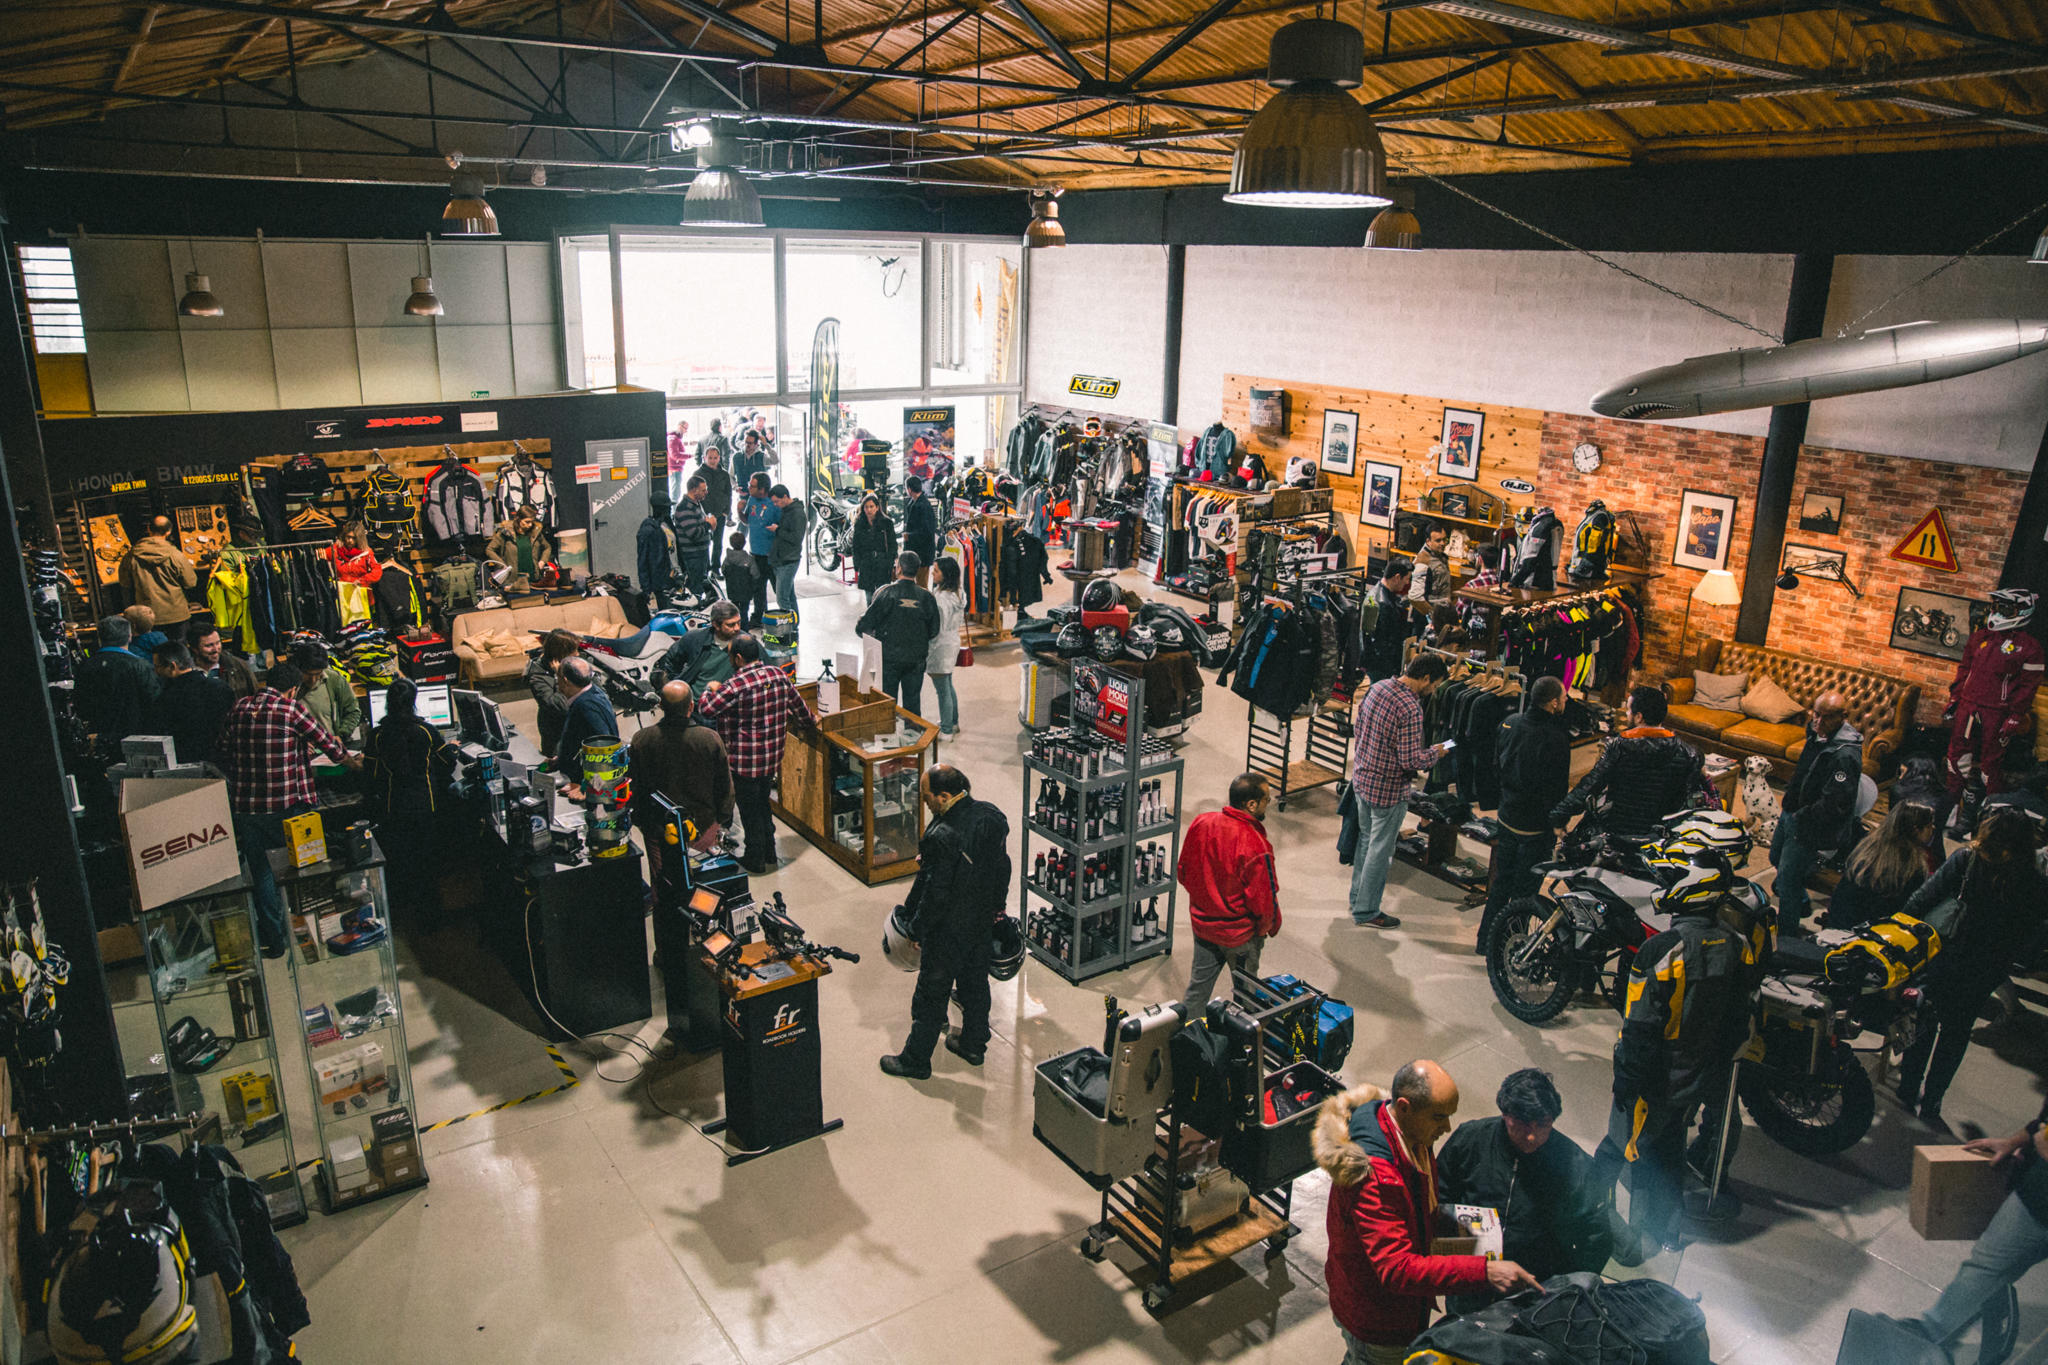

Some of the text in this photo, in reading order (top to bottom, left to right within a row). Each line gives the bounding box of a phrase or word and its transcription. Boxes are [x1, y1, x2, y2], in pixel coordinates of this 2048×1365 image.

[1071, 377, 1115, 395] Klim
[912, 411, 946, 421] Klim
[157, 463, 215, 482] BMW
[230, 472, 239, 481] LC
[78, 471, 136, 491] HONDA
[111, 479, 147, 493] AFRICA TWIN
[1504, 481, 1530, 491] HJC
[605, 470, 647, 508] TOURATECH
[1109, 677, 1128, 693] LIQUI
[1108, 689, 1128, 704] MOLY
[585, 754, 613, 764] 100%
[140, 823, 228, 866] SENA
